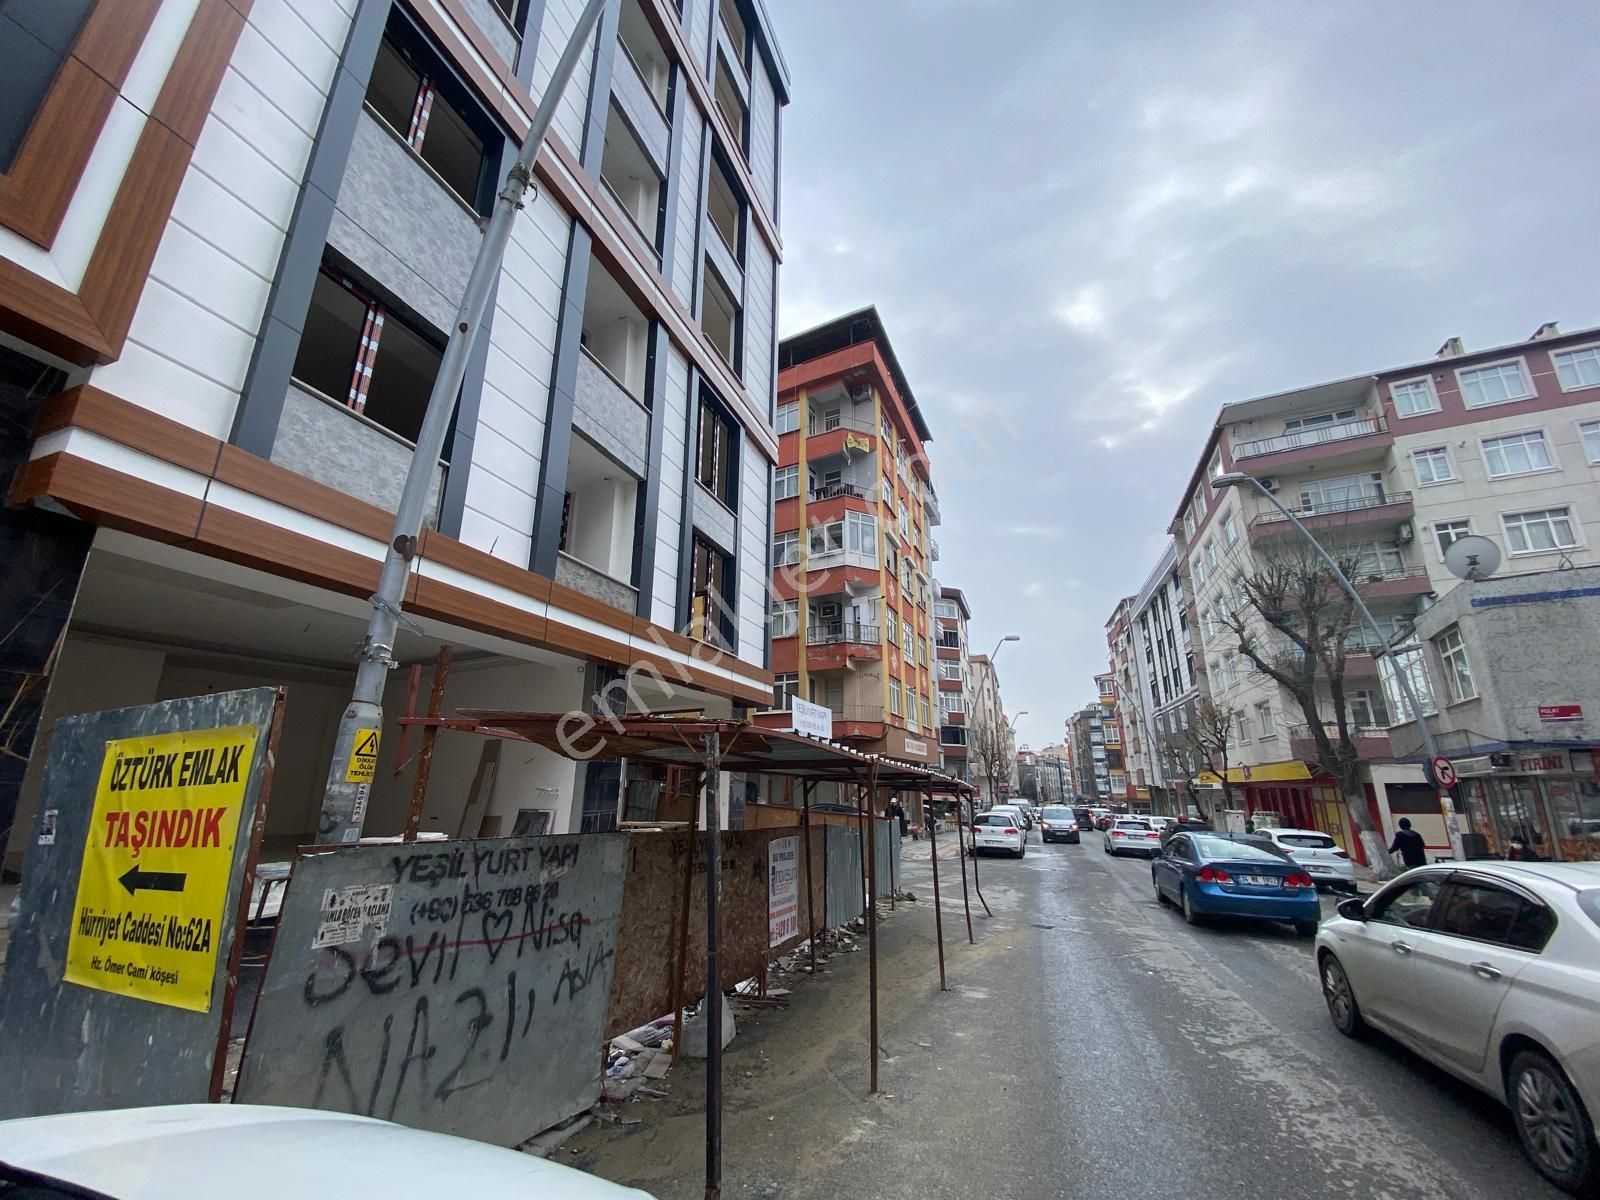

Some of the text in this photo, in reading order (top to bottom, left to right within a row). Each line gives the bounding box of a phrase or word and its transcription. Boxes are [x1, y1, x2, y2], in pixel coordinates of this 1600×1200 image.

[110, 744, 246, 792] ÖZTÜRK EMLAK
[105, 807, 227, 858] TAŞINDIK
[79, 907, 211, 953] Hürriyet Caddesi No:62A
[104, 955, 126, 975] Ömer
[126, 962, 150, 980] Cami
[149, 966, 179, 987] köşesi
